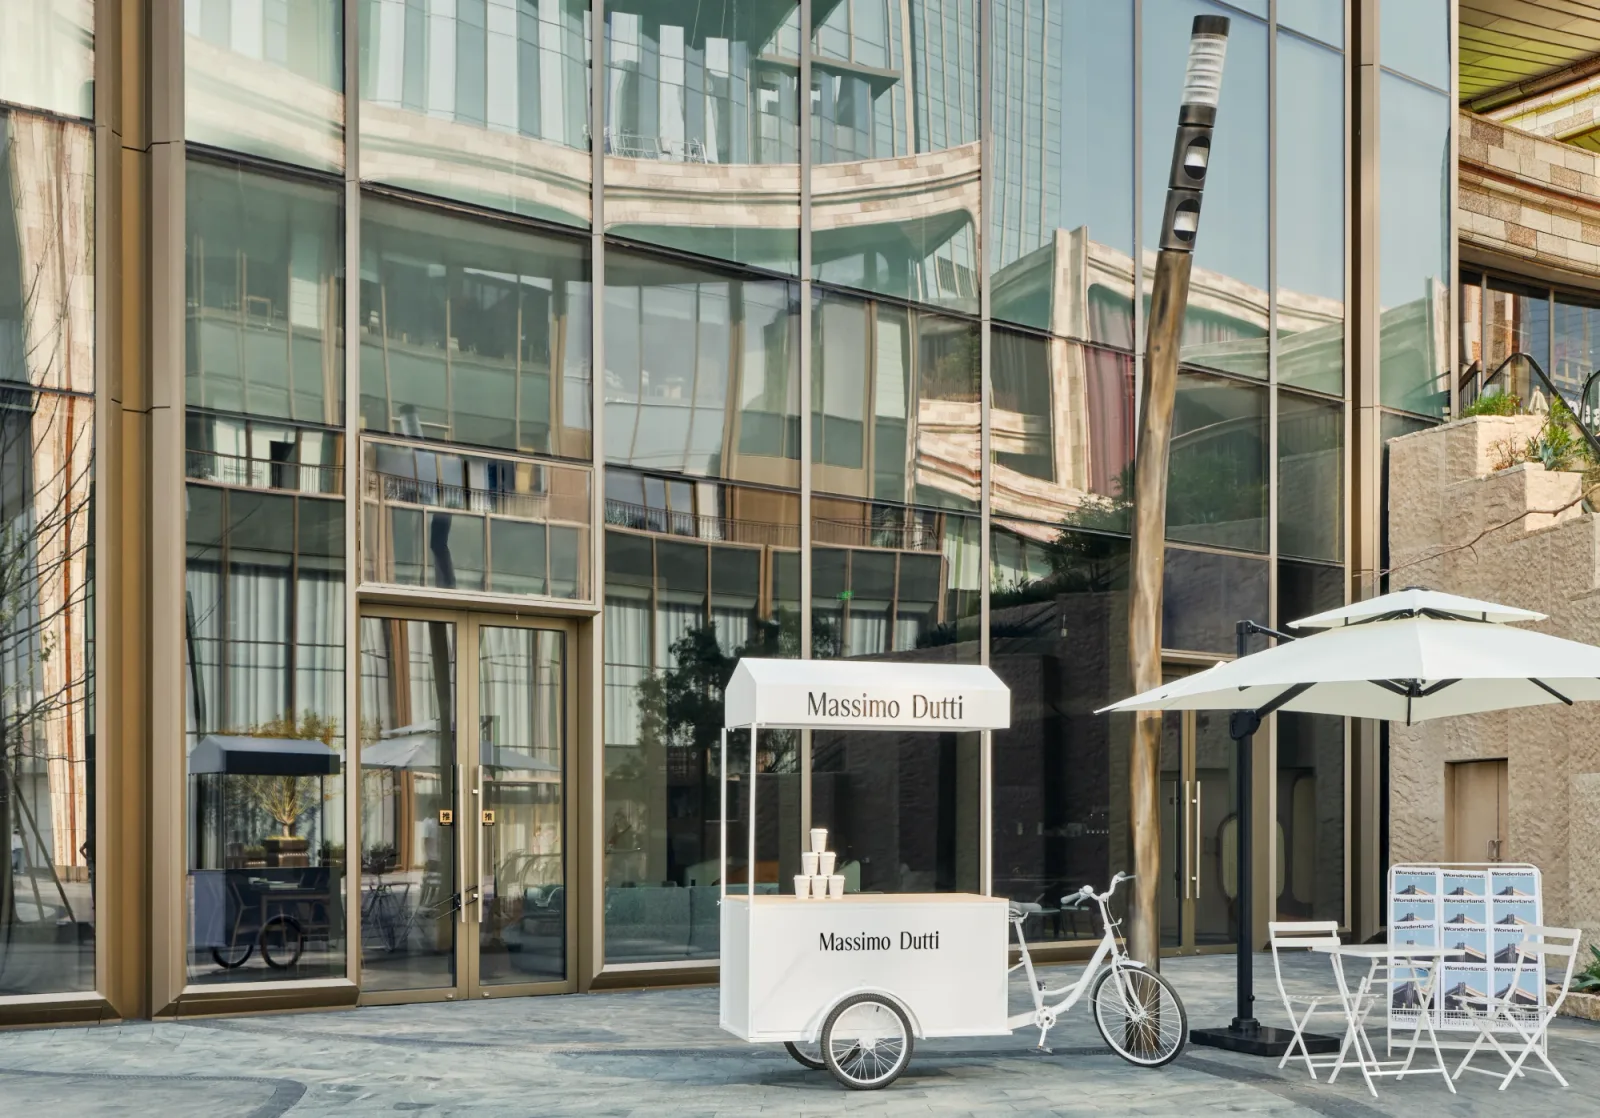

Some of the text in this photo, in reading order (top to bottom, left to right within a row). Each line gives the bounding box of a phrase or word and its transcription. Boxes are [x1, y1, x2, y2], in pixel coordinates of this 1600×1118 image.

[807, 691, 963, 719] Massimo Dutti
[819, 930, 940, 951] Massimo Dutti
